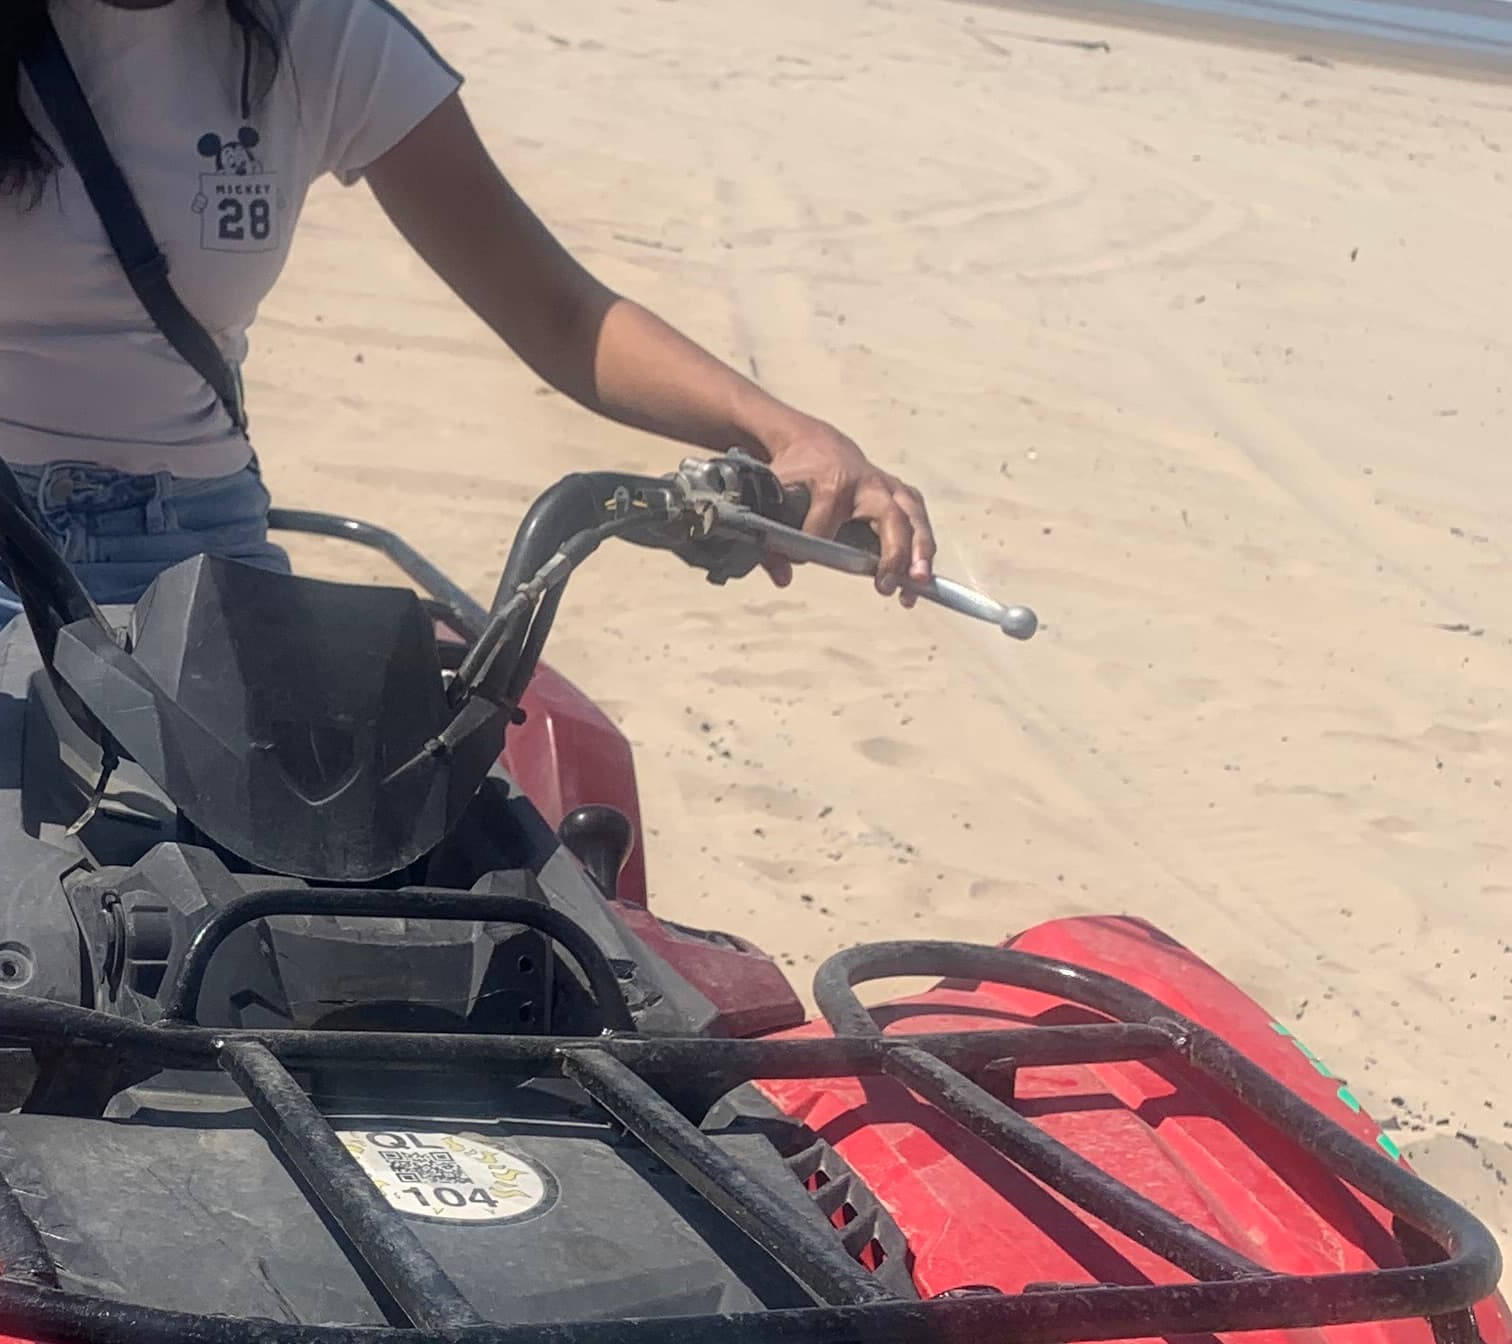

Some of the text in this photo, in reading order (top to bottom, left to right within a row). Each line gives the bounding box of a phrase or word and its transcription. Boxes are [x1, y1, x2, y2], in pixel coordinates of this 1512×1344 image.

[215, 184, 270, 195] MICKEY
[217, 197, 270, 241] 28
[365, 1131, 445, 1151] QL
[401, 1186, 499, 1208] 104
